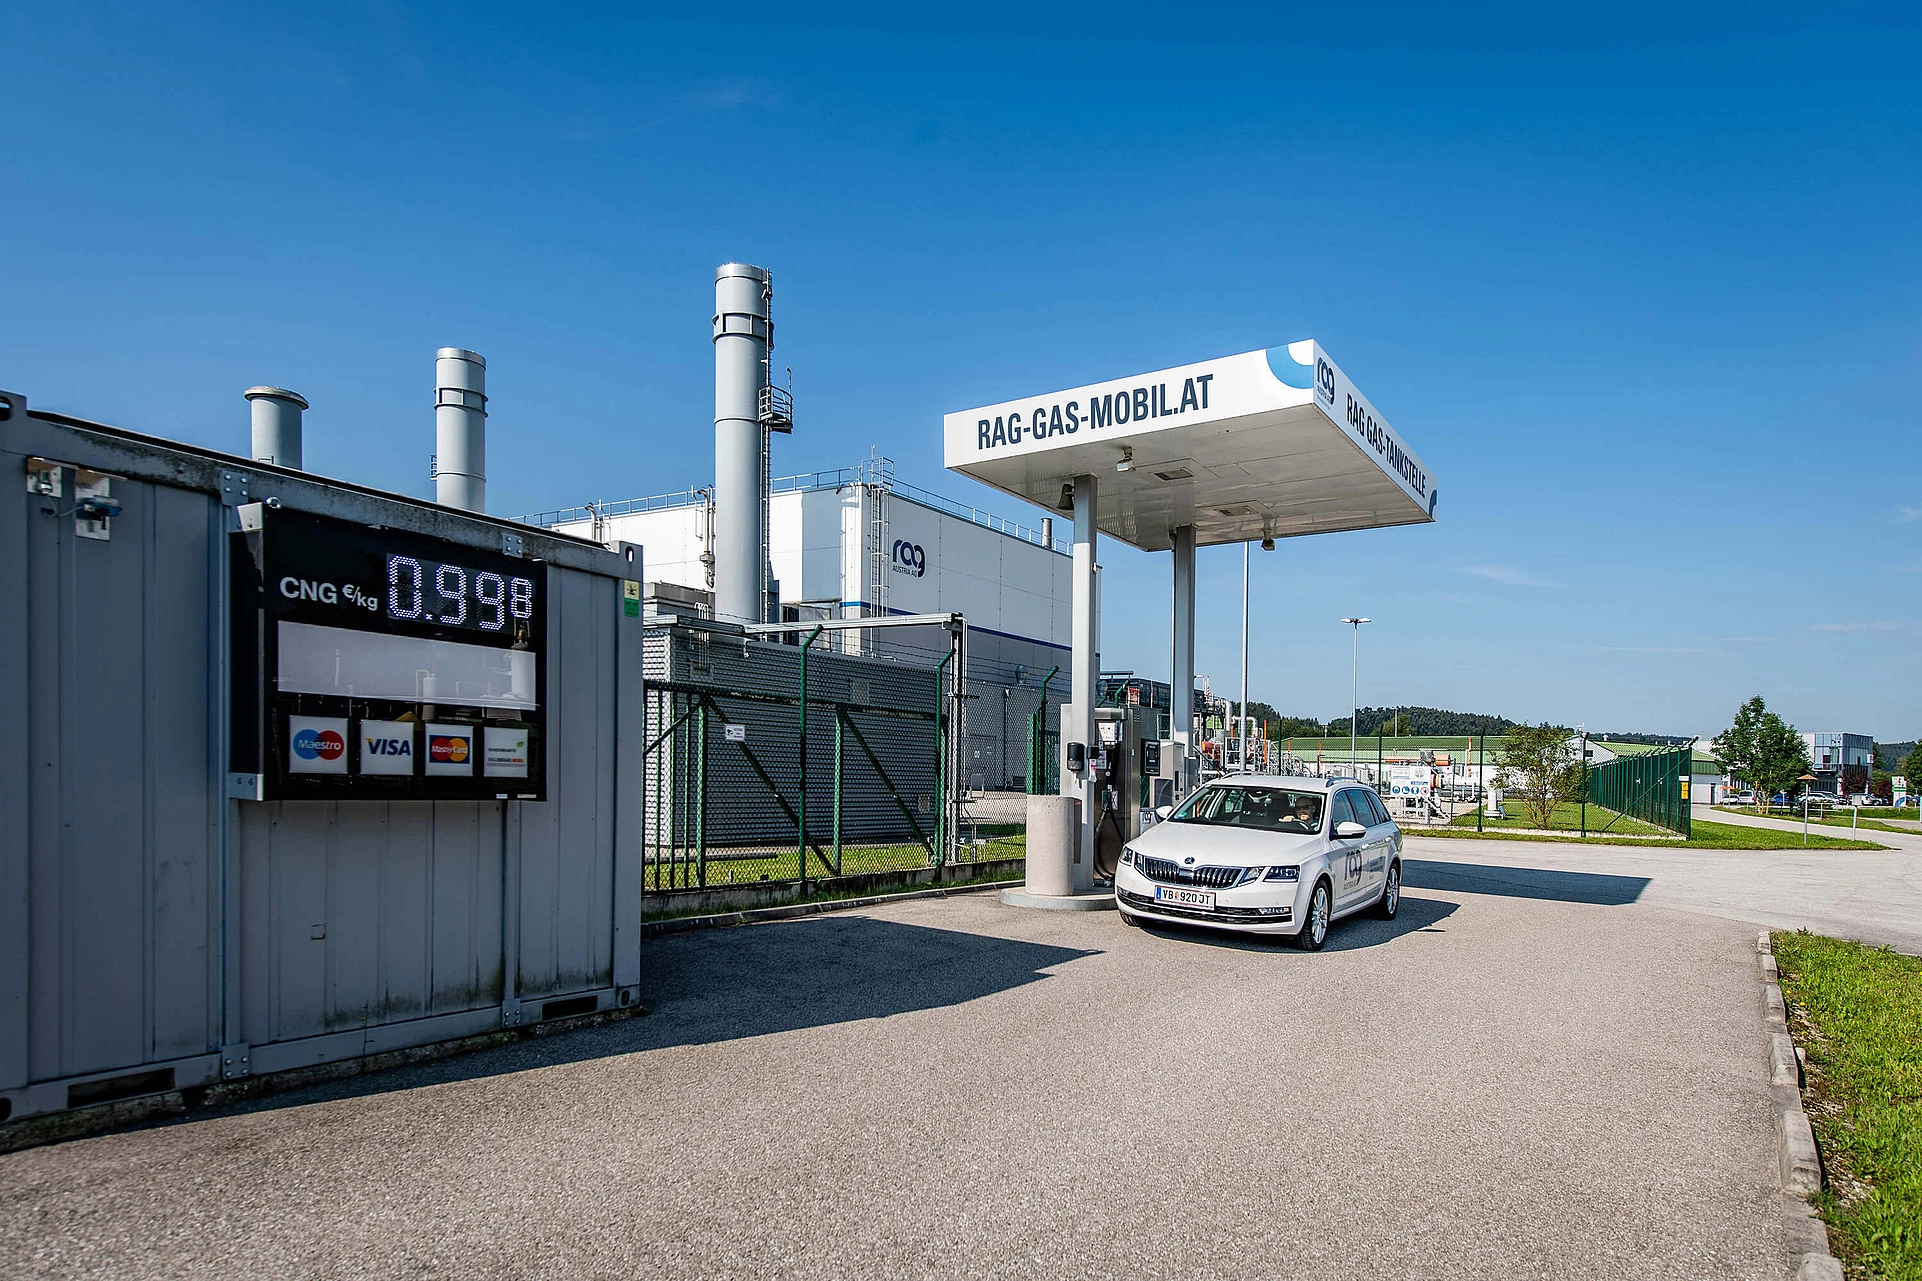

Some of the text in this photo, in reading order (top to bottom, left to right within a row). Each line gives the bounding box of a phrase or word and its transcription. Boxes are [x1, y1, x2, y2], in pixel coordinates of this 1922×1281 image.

[1317, 357, 1335, 405] rag
[978, 373, 1214, 450] RAG-GAS-MOBIL.AT
[1347, 392, 1426, 499] RAG GAS-TANKSTELLE
[892, 539, 925, 578] rag
[279, 576, 379, 611] CNG €/kg
[388, 555, 532, 631] 0.998
[297, 740, 342, 751] Maestro
[367, 738, 411, 756] VISA
[431, 745, 469, 754] MasterCard
[1163, 889, 1211, 905] VB 920 JT
